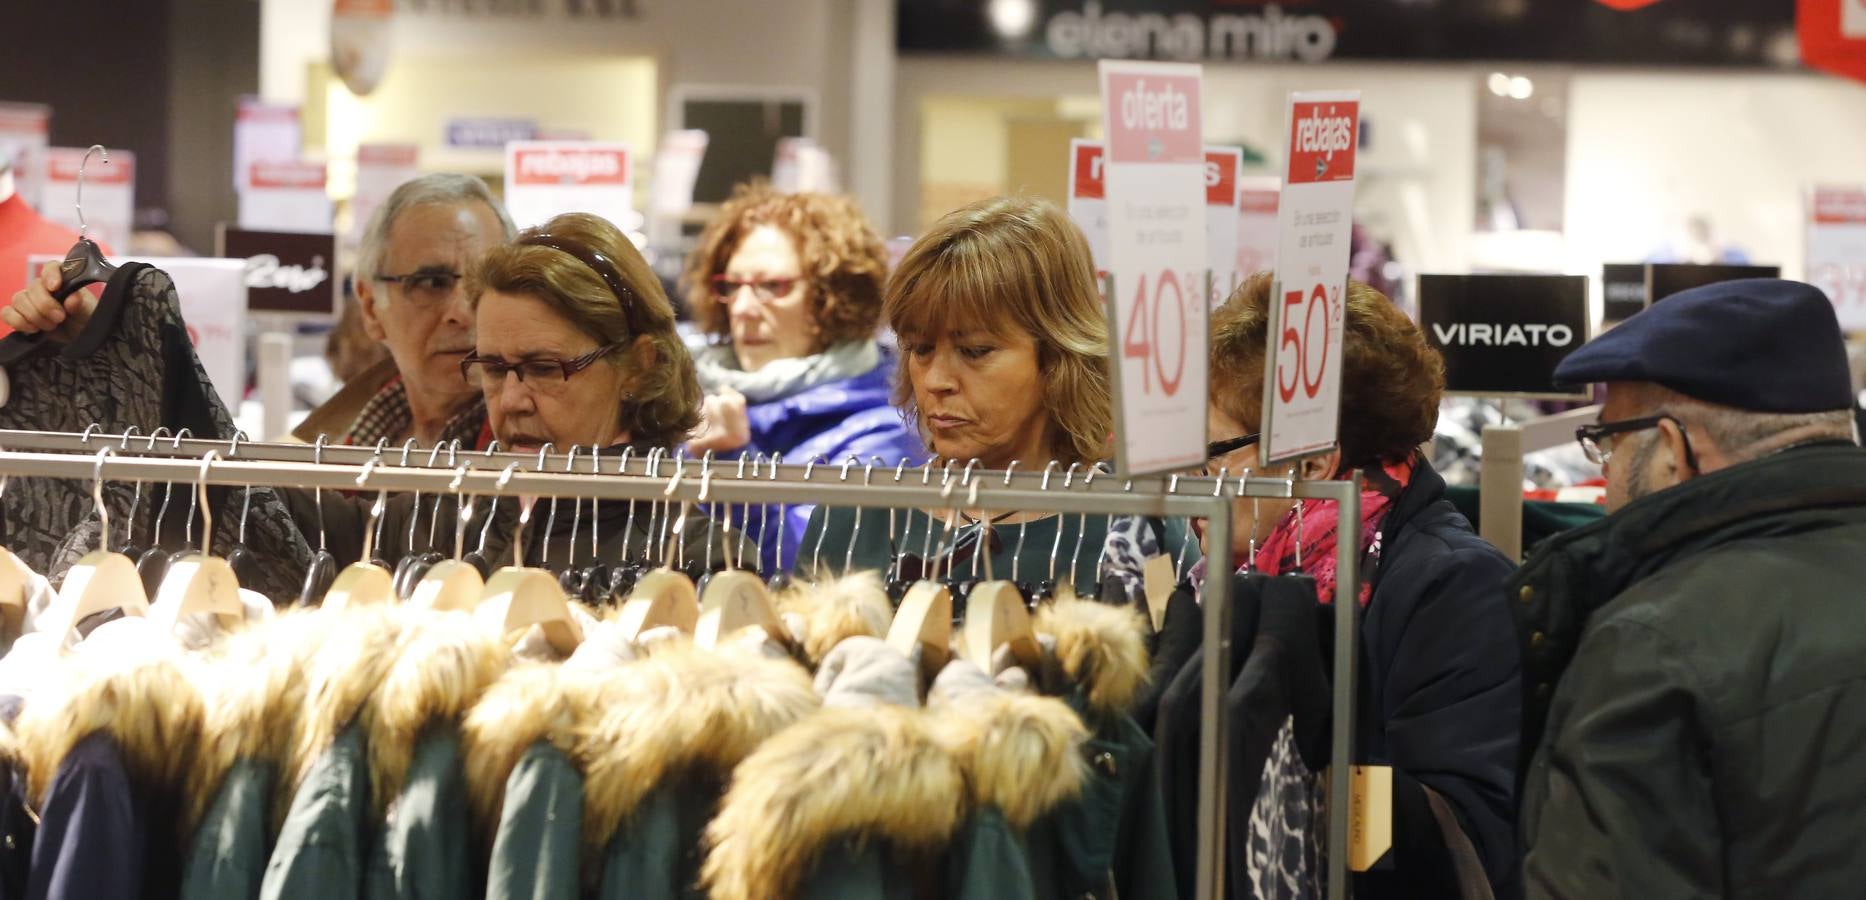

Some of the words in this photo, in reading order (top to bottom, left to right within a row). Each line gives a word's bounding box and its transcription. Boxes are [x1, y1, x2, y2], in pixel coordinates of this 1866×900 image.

[1121, 79, 1188, 131] oferta
[1295, 106, 1352, 162] rebajas
[1432, 323, 1573, 347] VIRIATO
